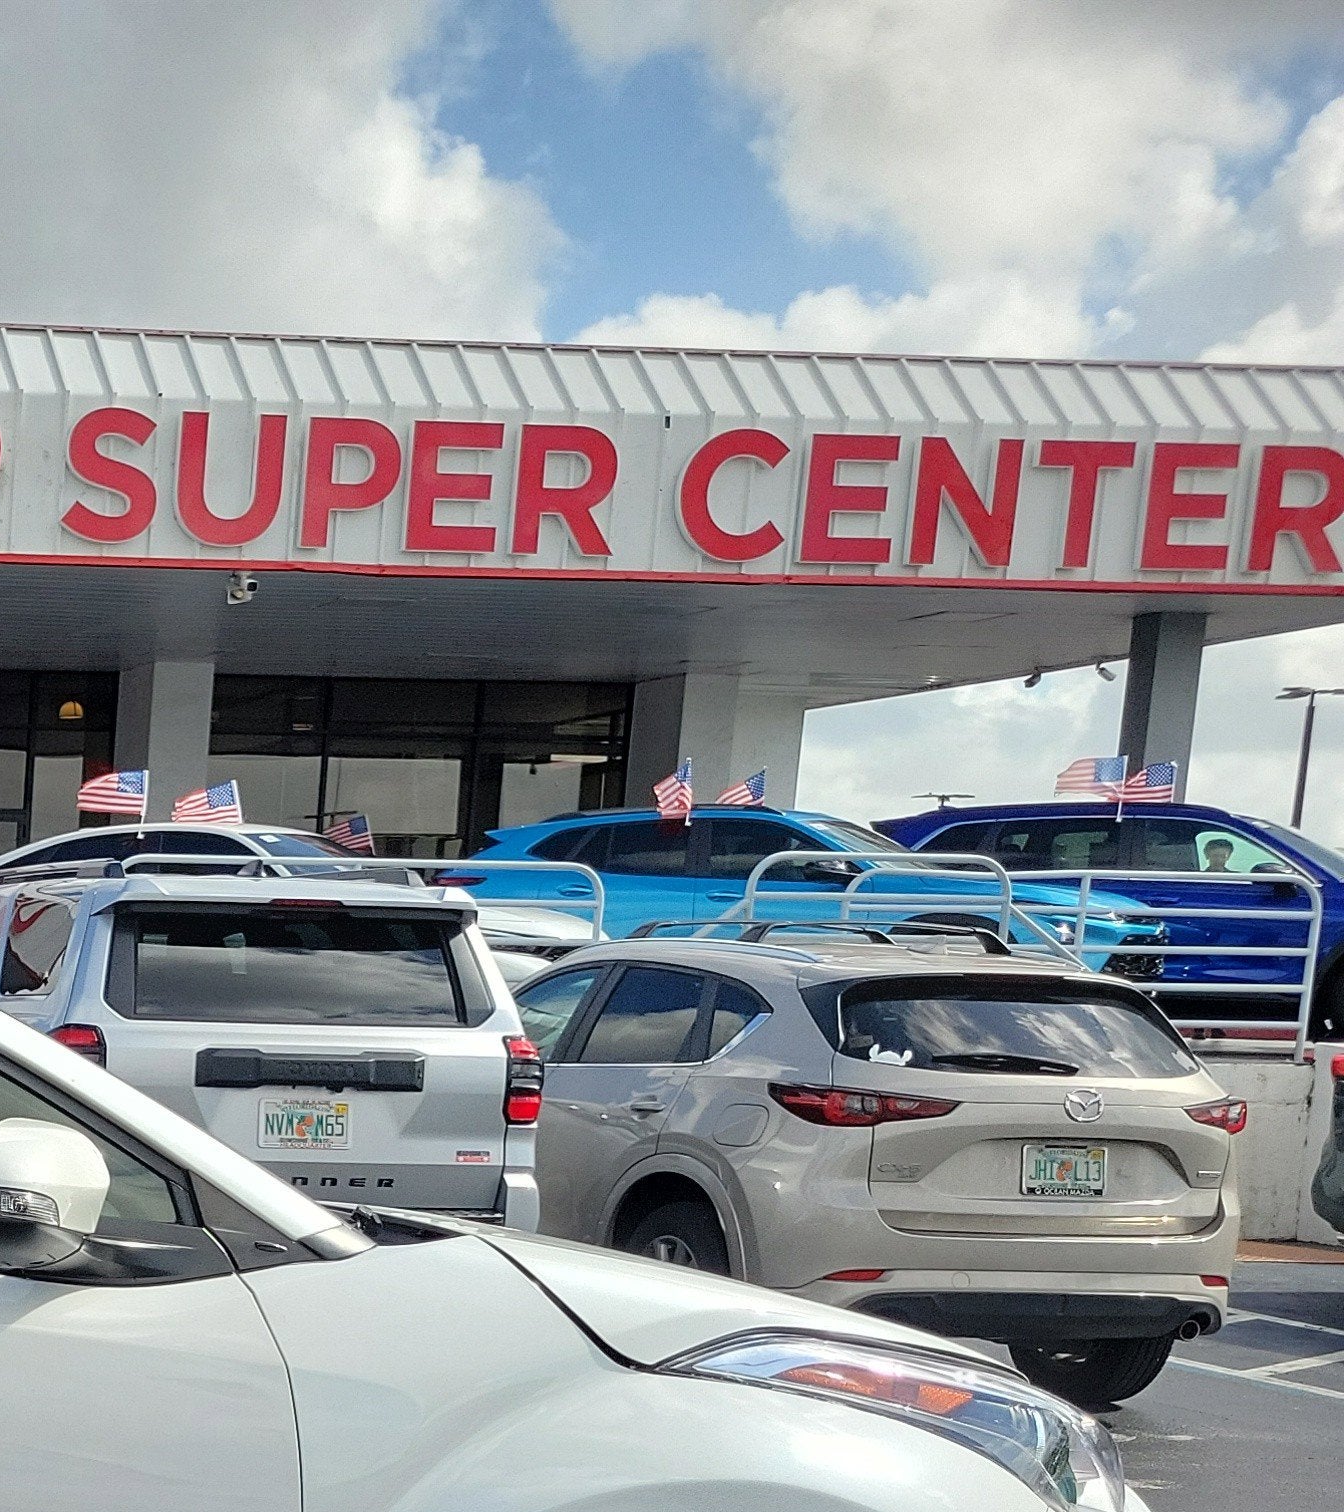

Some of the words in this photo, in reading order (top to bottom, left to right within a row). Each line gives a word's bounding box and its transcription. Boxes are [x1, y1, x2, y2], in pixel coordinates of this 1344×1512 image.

[61, 407, 619, 556] SUPER
[680, 428, 1344, 572] CENTER
[264, 1113, 294, 1136] NVM
[315, 1114, 345, 1137] M65
